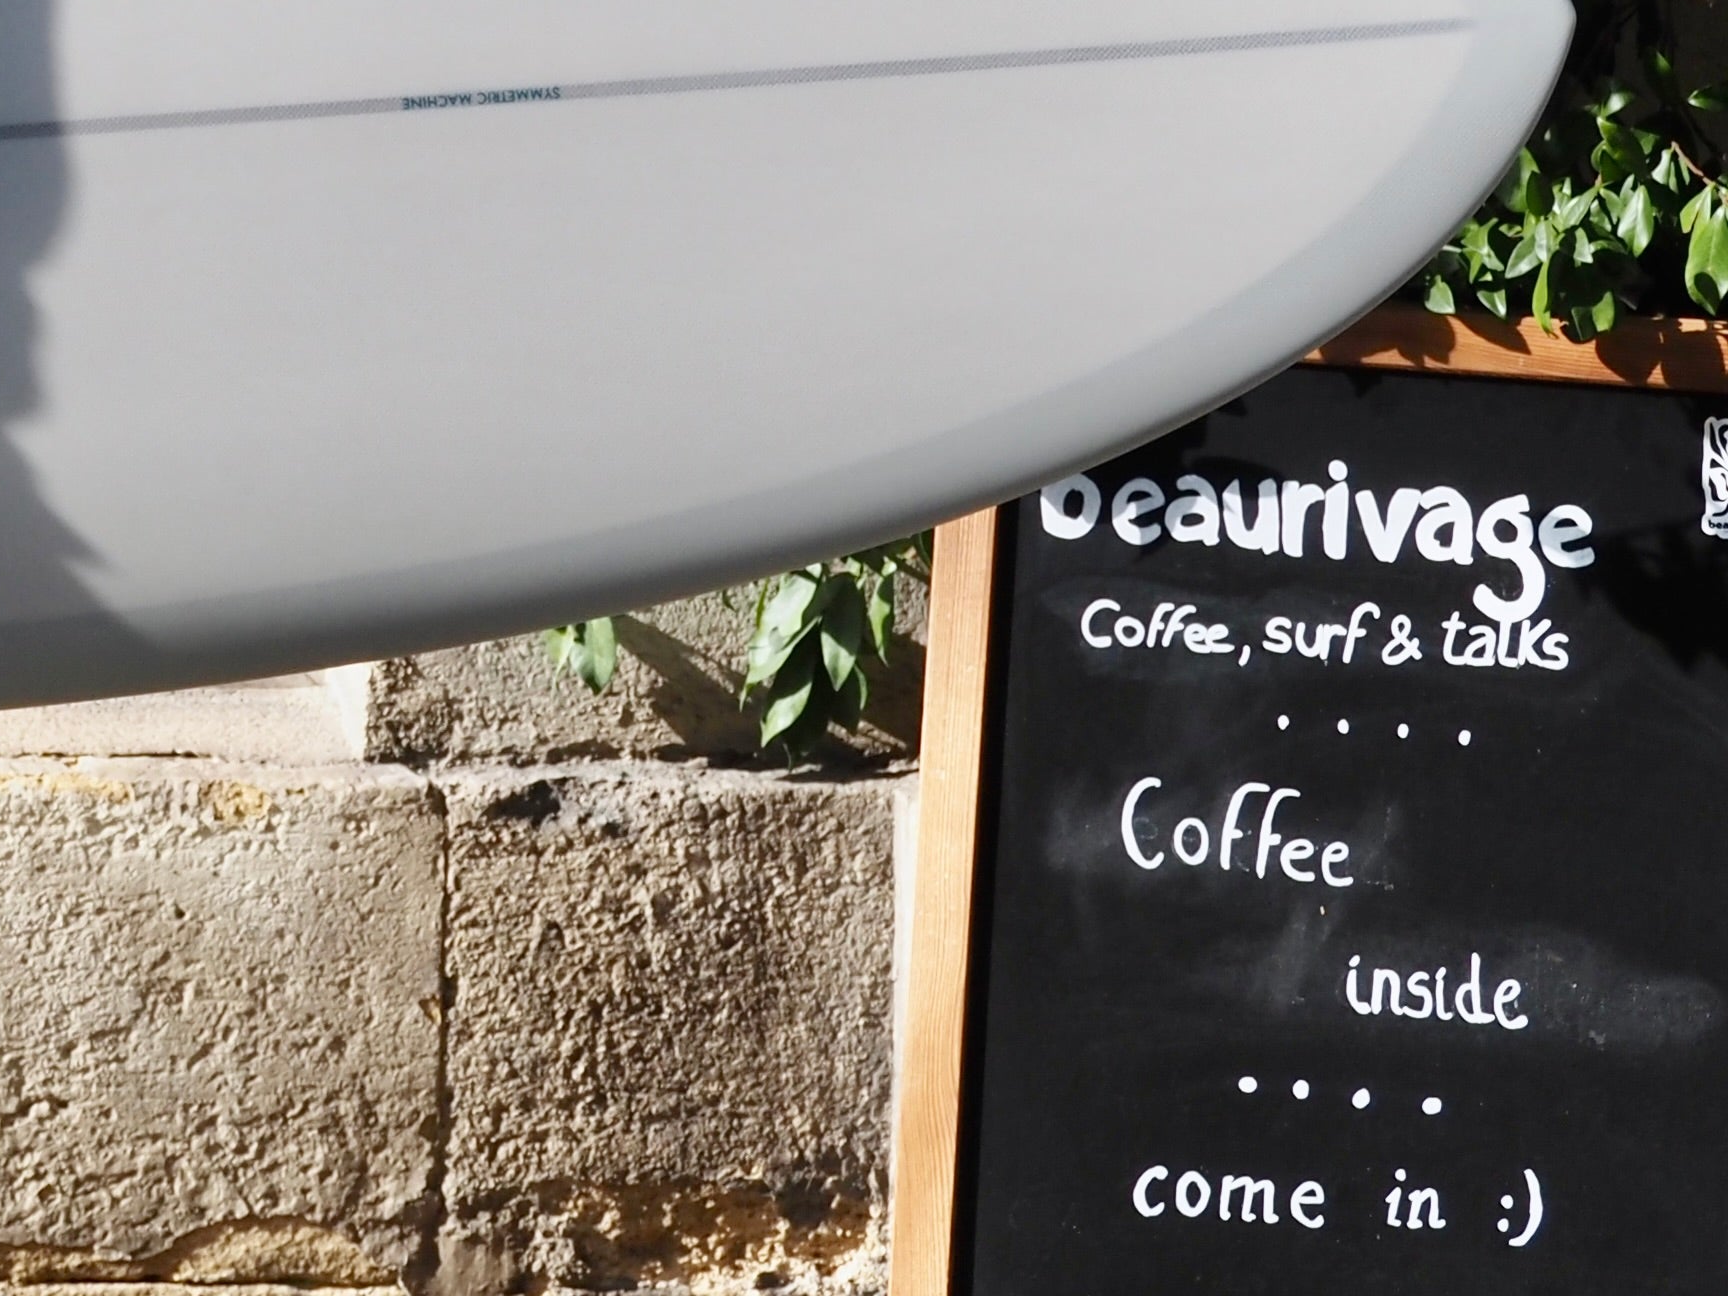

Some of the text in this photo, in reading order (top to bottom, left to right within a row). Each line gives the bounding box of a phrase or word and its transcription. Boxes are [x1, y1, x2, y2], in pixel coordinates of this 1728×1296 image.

[401, 85, 562, 111] SYMMETRIC MACHINE
[1081, 598, 1570, 671] Coffee, surf & talks
[1121, 776, 1354, 888] Coffee
[1346, 951, 1529, 1030] inside
[1133, 1165, 1325, 1229] come
[1385, 1168, 1447, 1230] in
